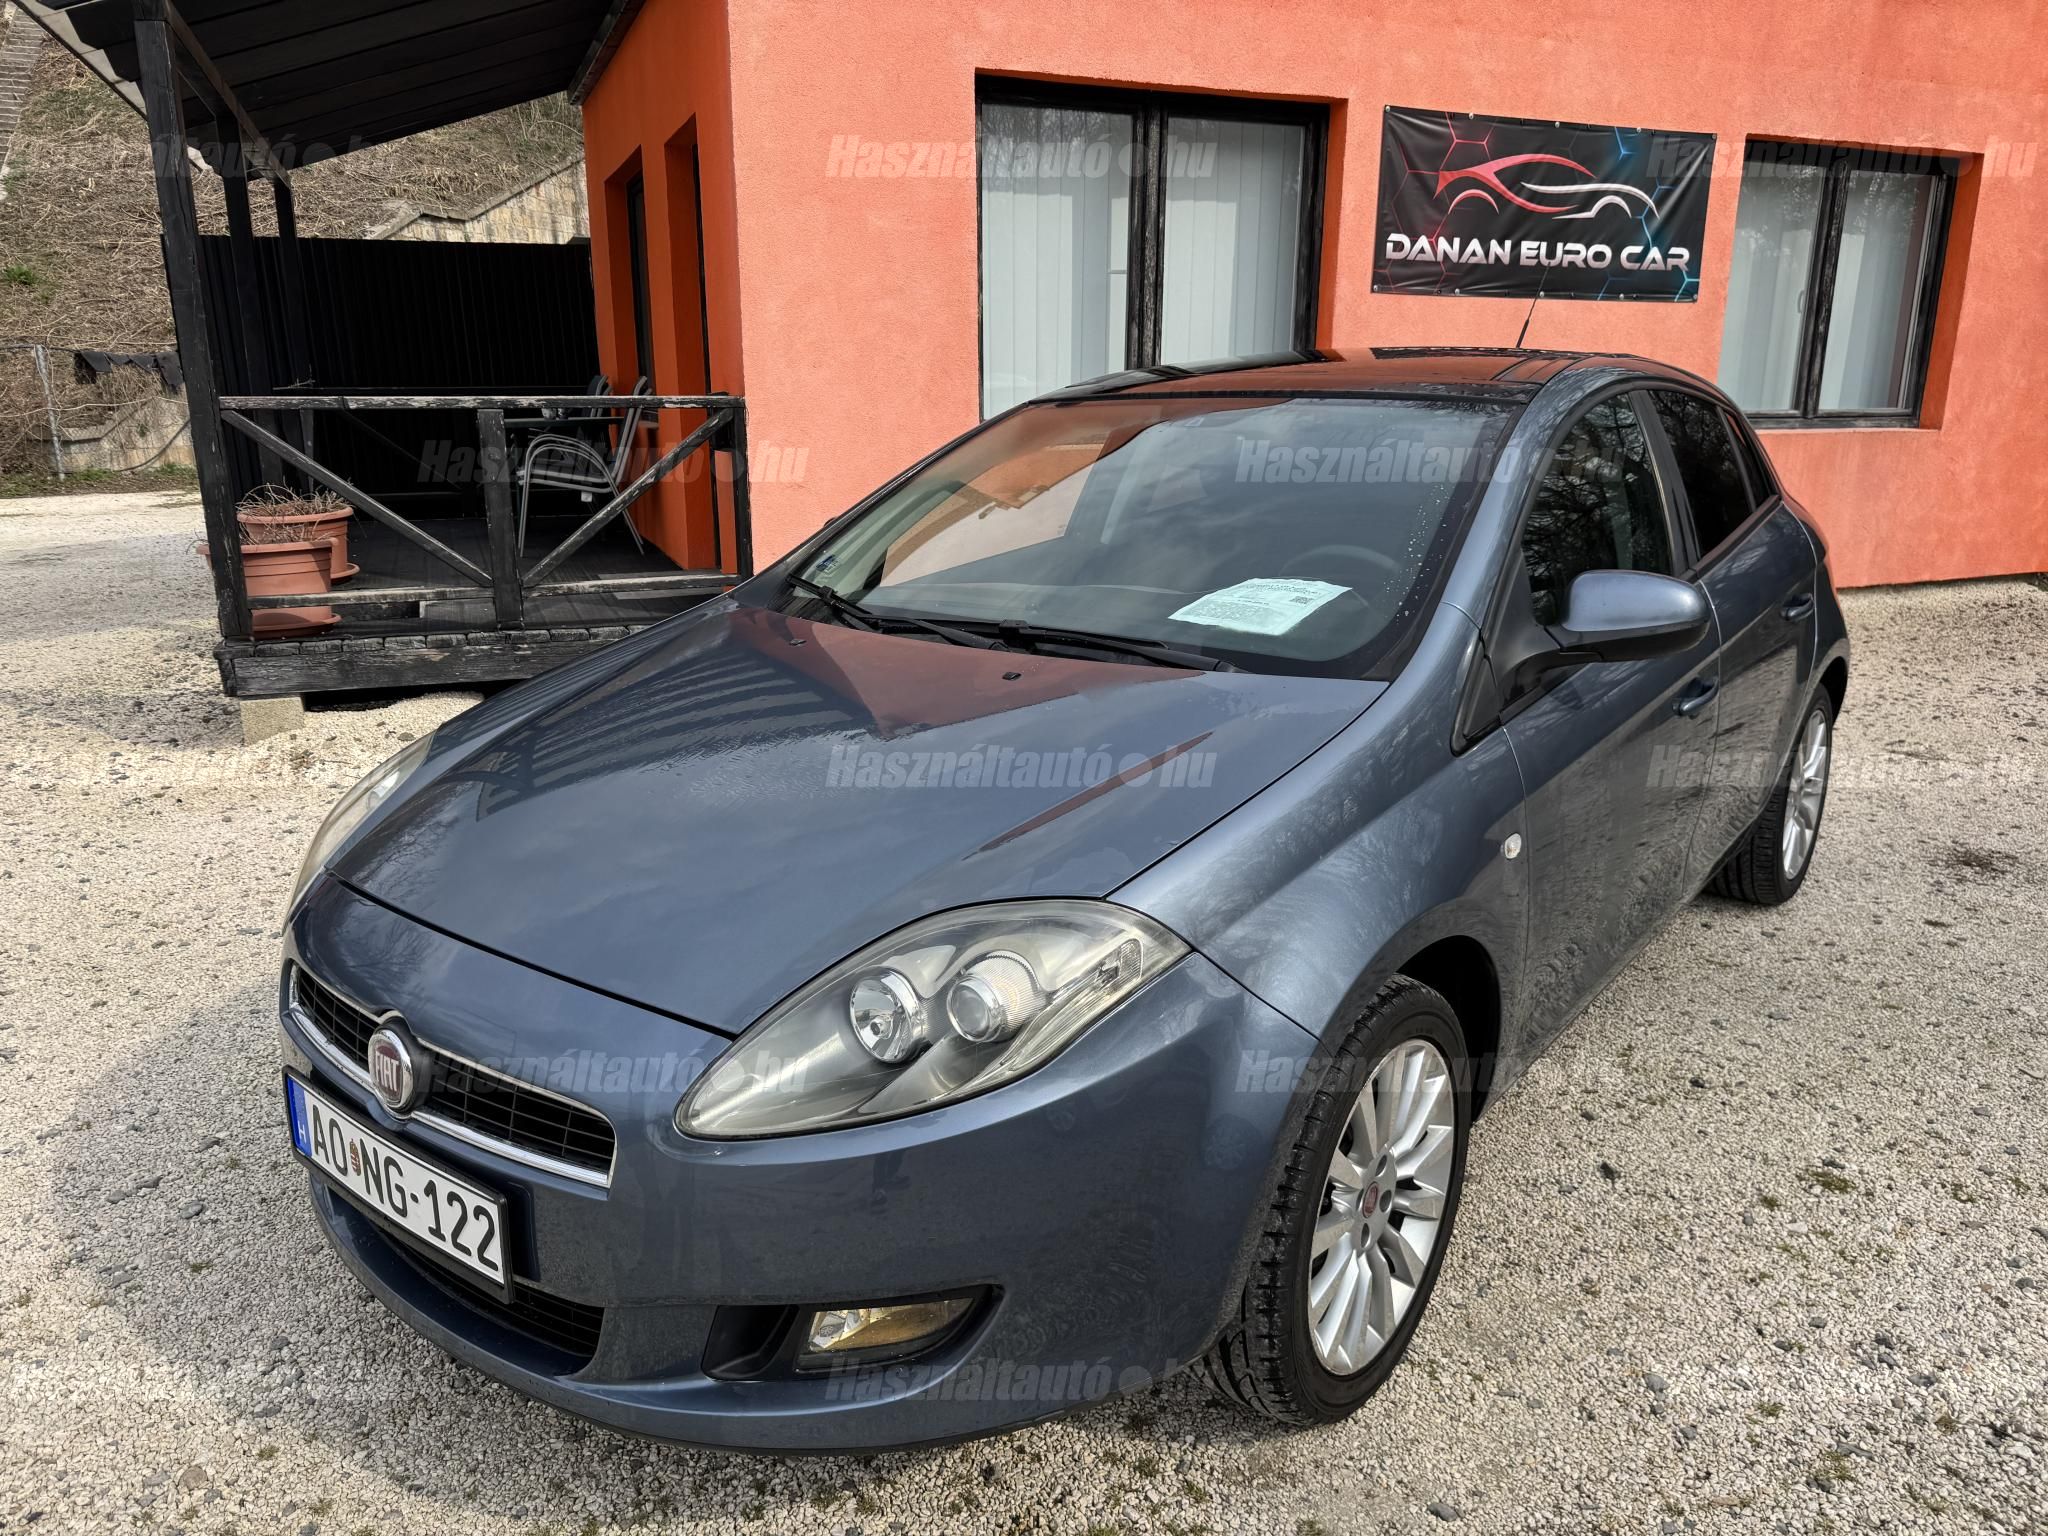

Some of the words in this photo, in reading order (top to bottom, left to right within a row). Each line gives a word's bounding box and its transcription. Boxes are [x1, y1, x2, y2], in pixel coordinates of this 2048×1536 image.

[1386, 233, 1512, 265] DANAN
[1519, 240, 1612, 269] EURO
[1620, 246, 1690, 272] CAR
[375, 1050, 399, 1092] FIAT
